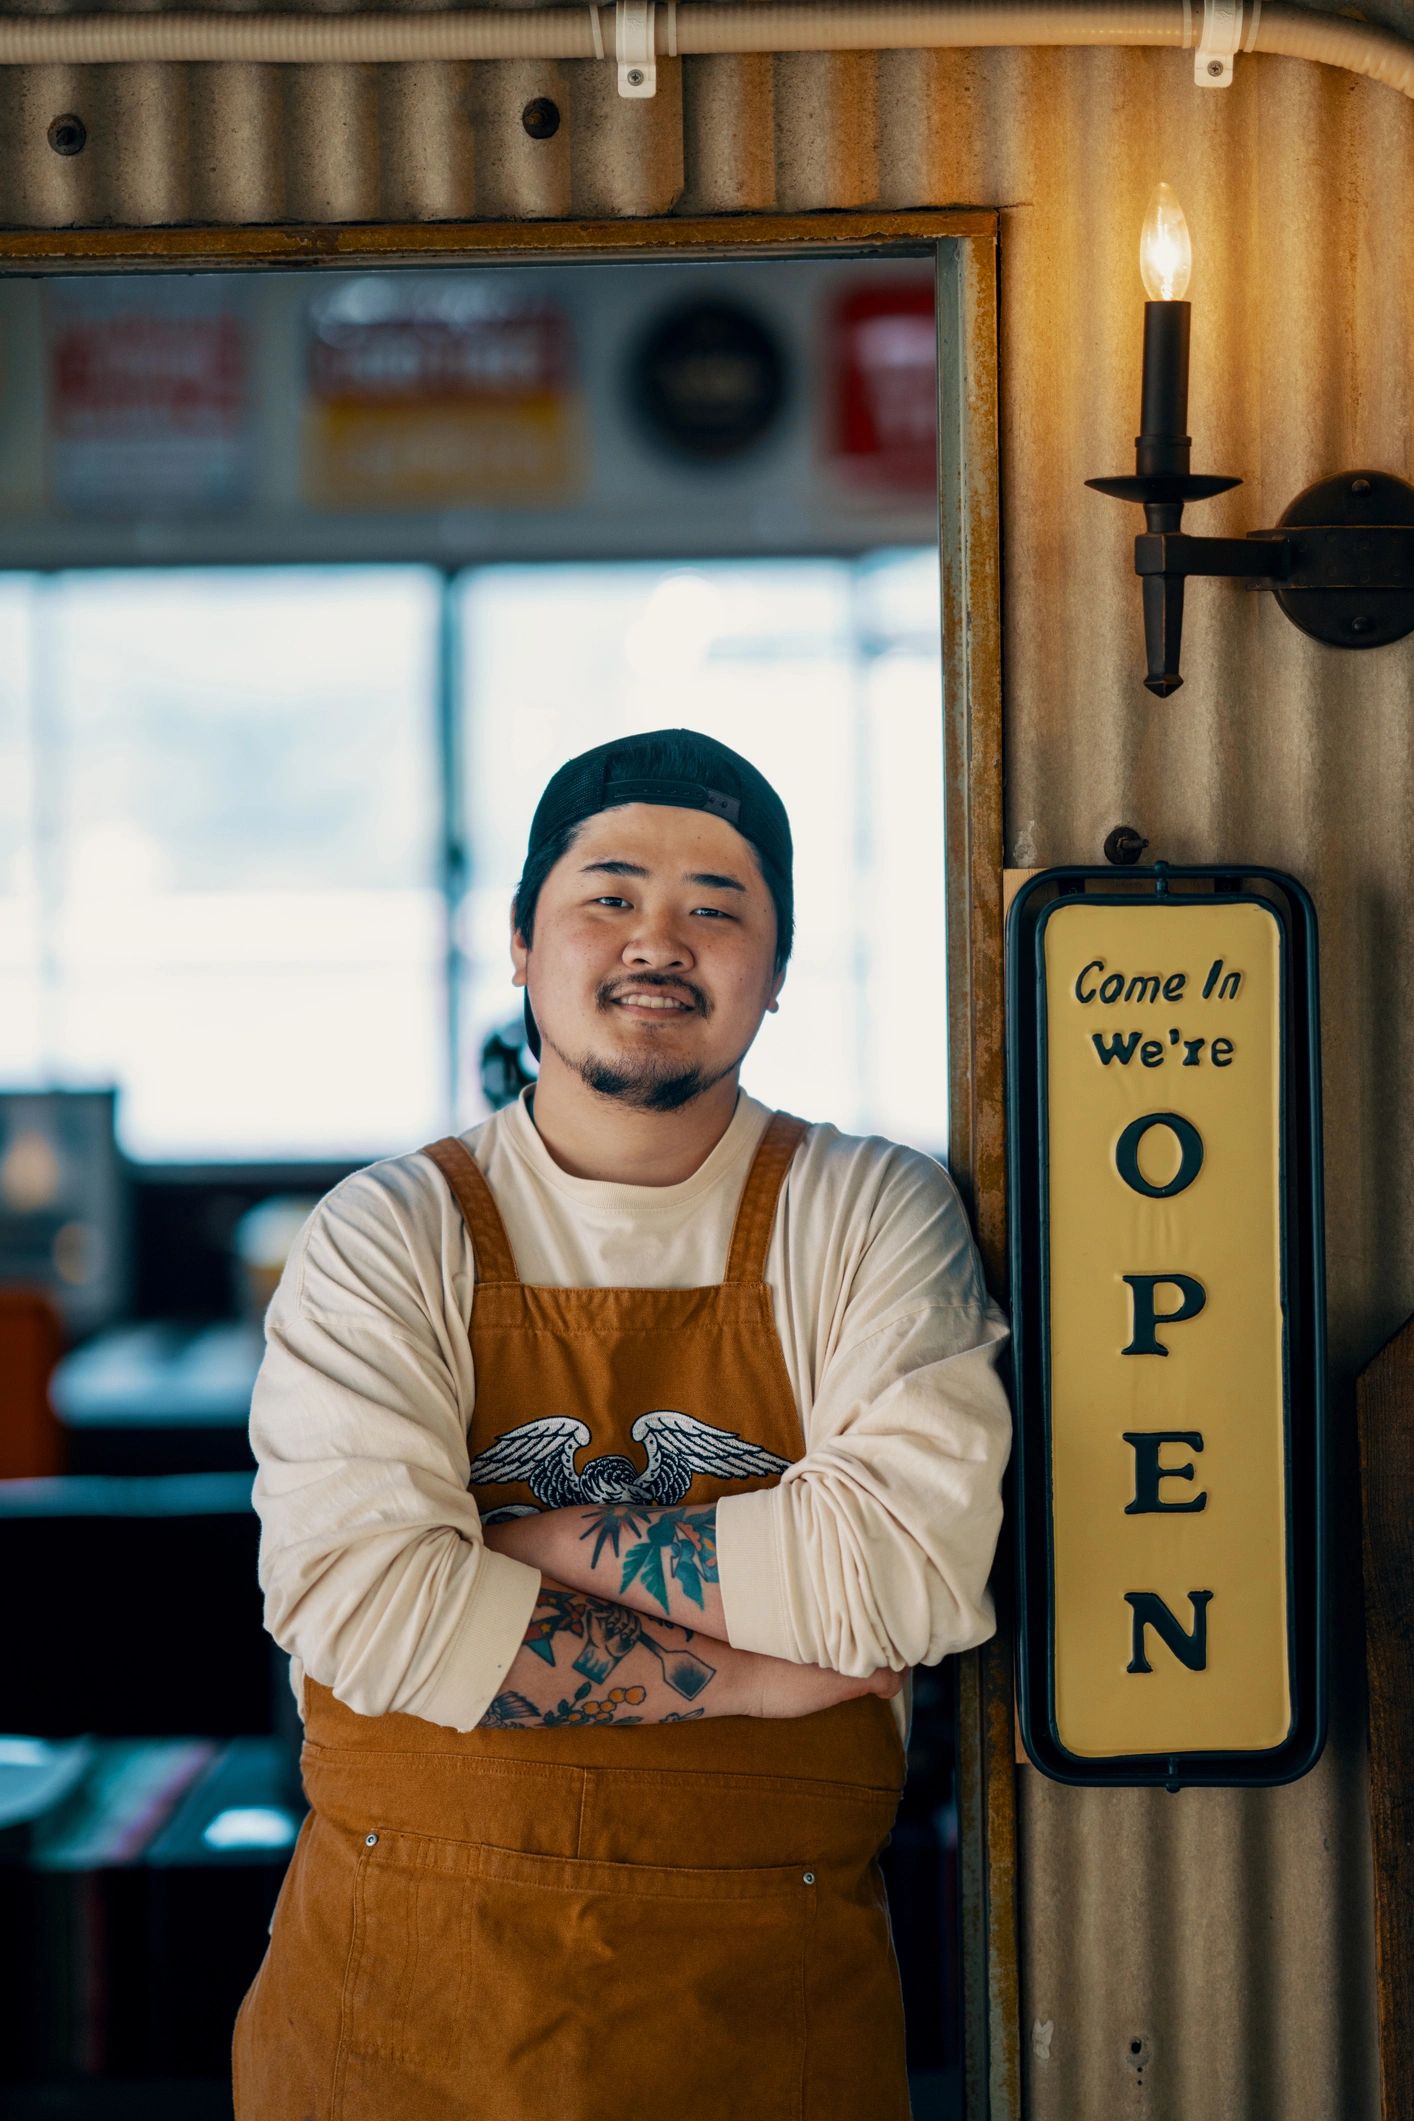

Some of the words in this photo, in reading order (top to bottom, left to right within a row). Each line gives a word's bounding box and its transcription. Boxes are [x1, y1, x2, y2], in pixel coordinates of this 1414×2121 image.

[1075, 960, 1187, 1005] Come
[1202, 959, 1242, 1000] In
[1092, 1028, 1234, 1068] We're
[1115, 1111, 1214, 1675] OPEN
